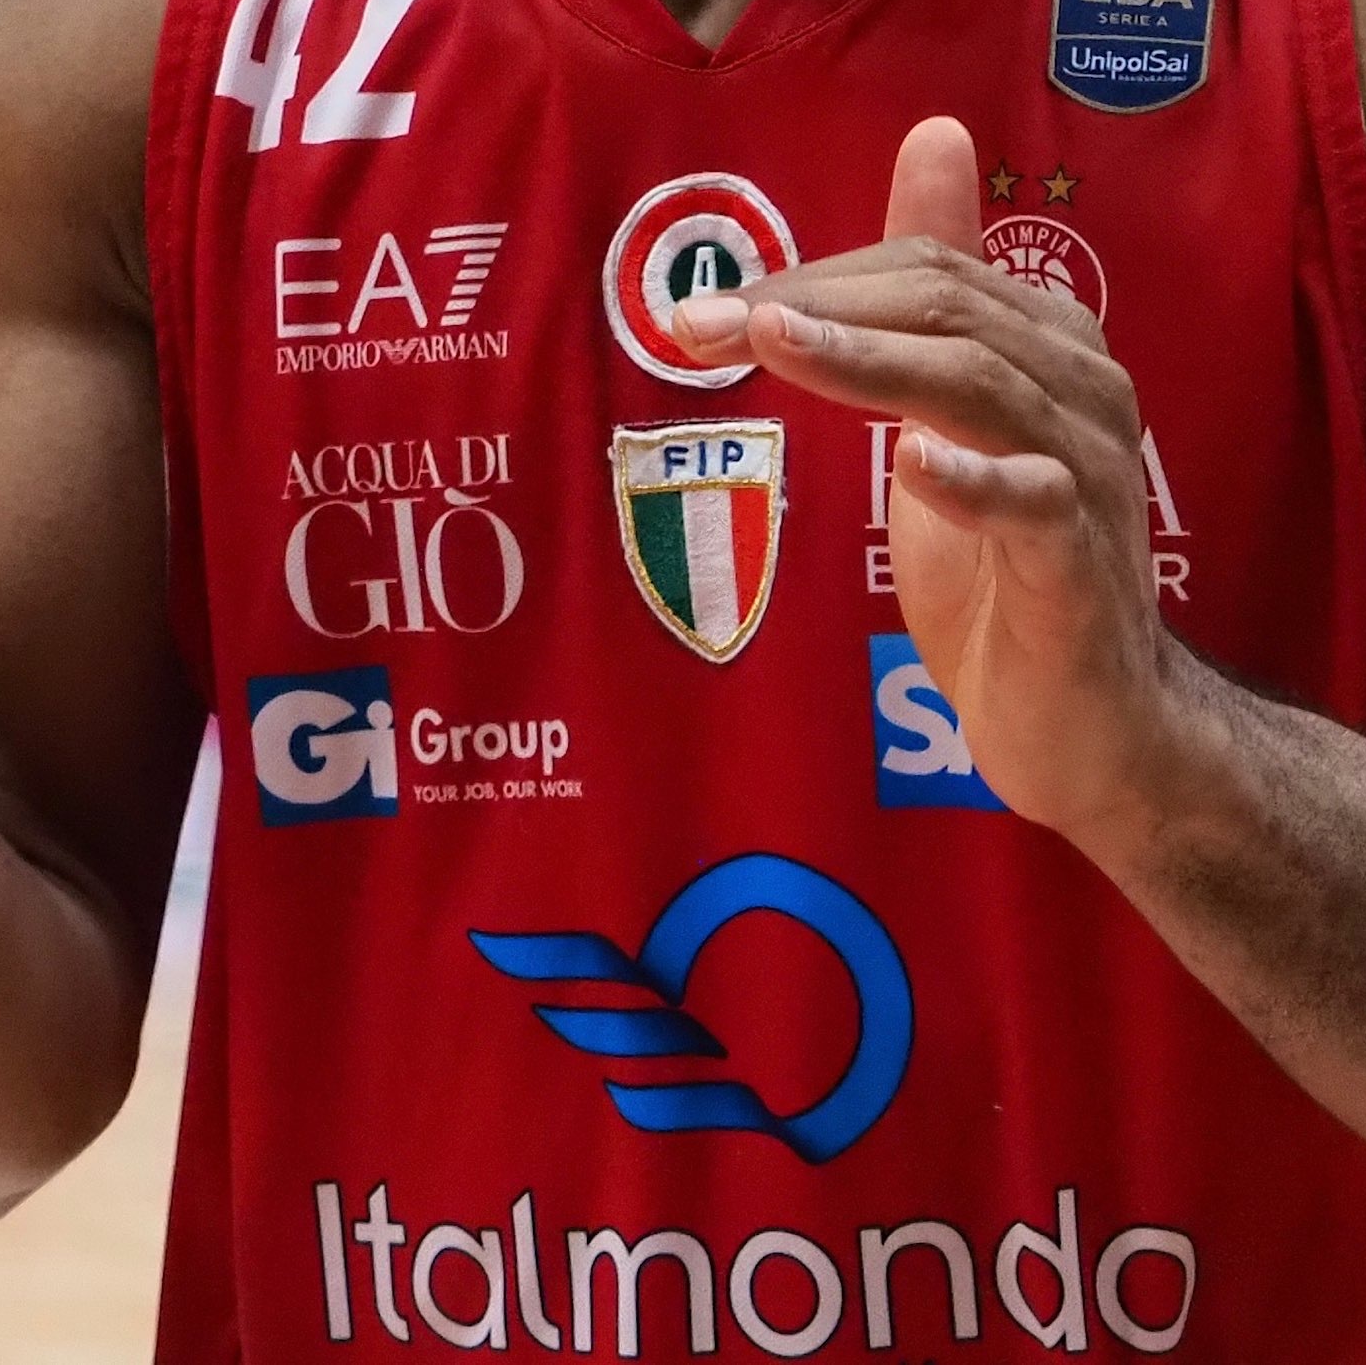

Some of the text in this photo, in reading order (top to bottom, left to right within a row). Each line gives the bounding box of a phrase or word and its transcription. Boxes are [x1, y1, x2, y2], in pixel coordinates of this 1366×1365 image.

[1098, 11, 1168, 26] SERIE A
[1070, 46, 1190, 80] UnipolSai
[985, 224, 1072, 257] OLIMPIA
[275, 222, 509, 338] EA7
[276, 330, 509, 374] EMPORIO ARMANI
[281, 433, 514, 500] ACQUA DI
[663, 440, 745, 478] FIP
[284, 487, 525, 639] GIÒ
[251, 689, 569, 805] Gi Group
[413, 779, 583, 803] YOUR JOB, OUR WORK
[313, 1180, 1196, 1357] Italmondo
